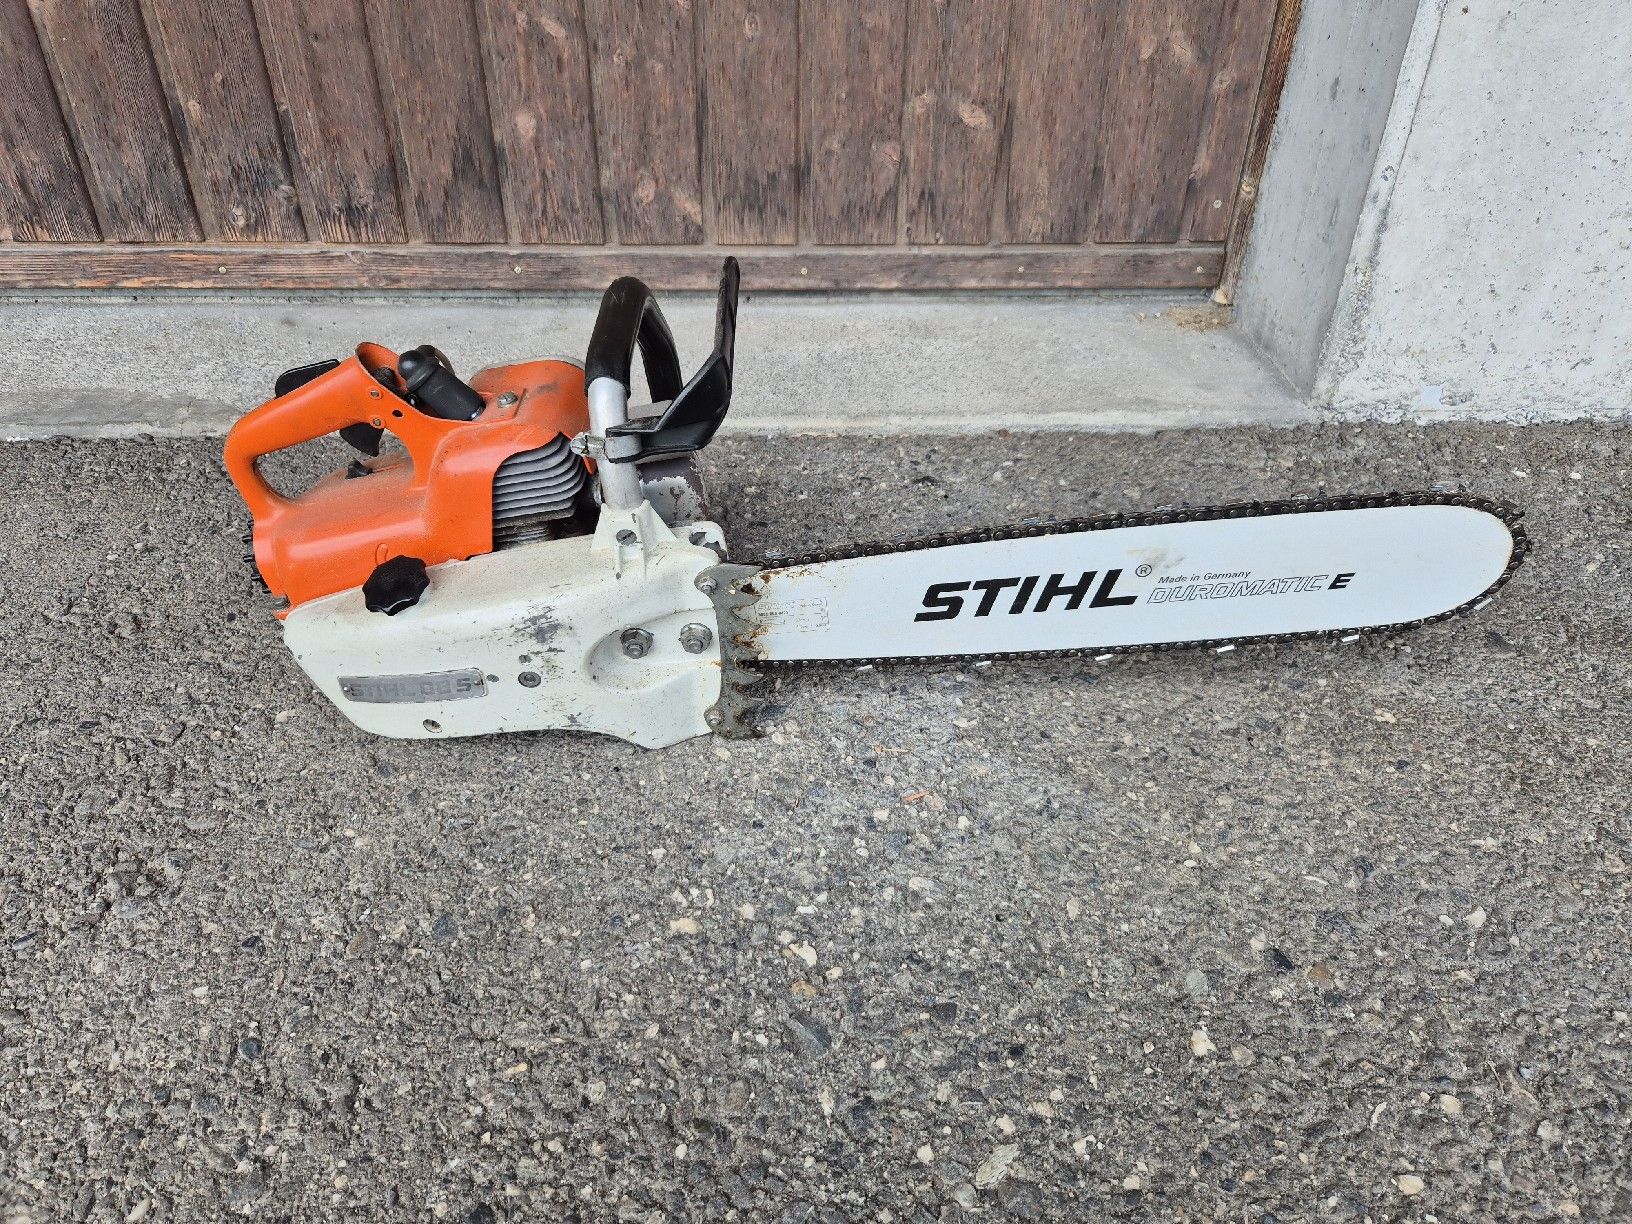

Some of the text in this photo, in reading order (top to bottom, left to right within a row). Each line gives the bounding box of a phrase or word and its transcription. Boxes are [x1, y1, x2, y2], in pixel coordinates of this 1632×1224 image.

[1147, 572, 1356, 604] DUROMATIC E
[1158, 571, 1252, 584] Made in Germany
[913, 568, 1139, 623] STIHL
